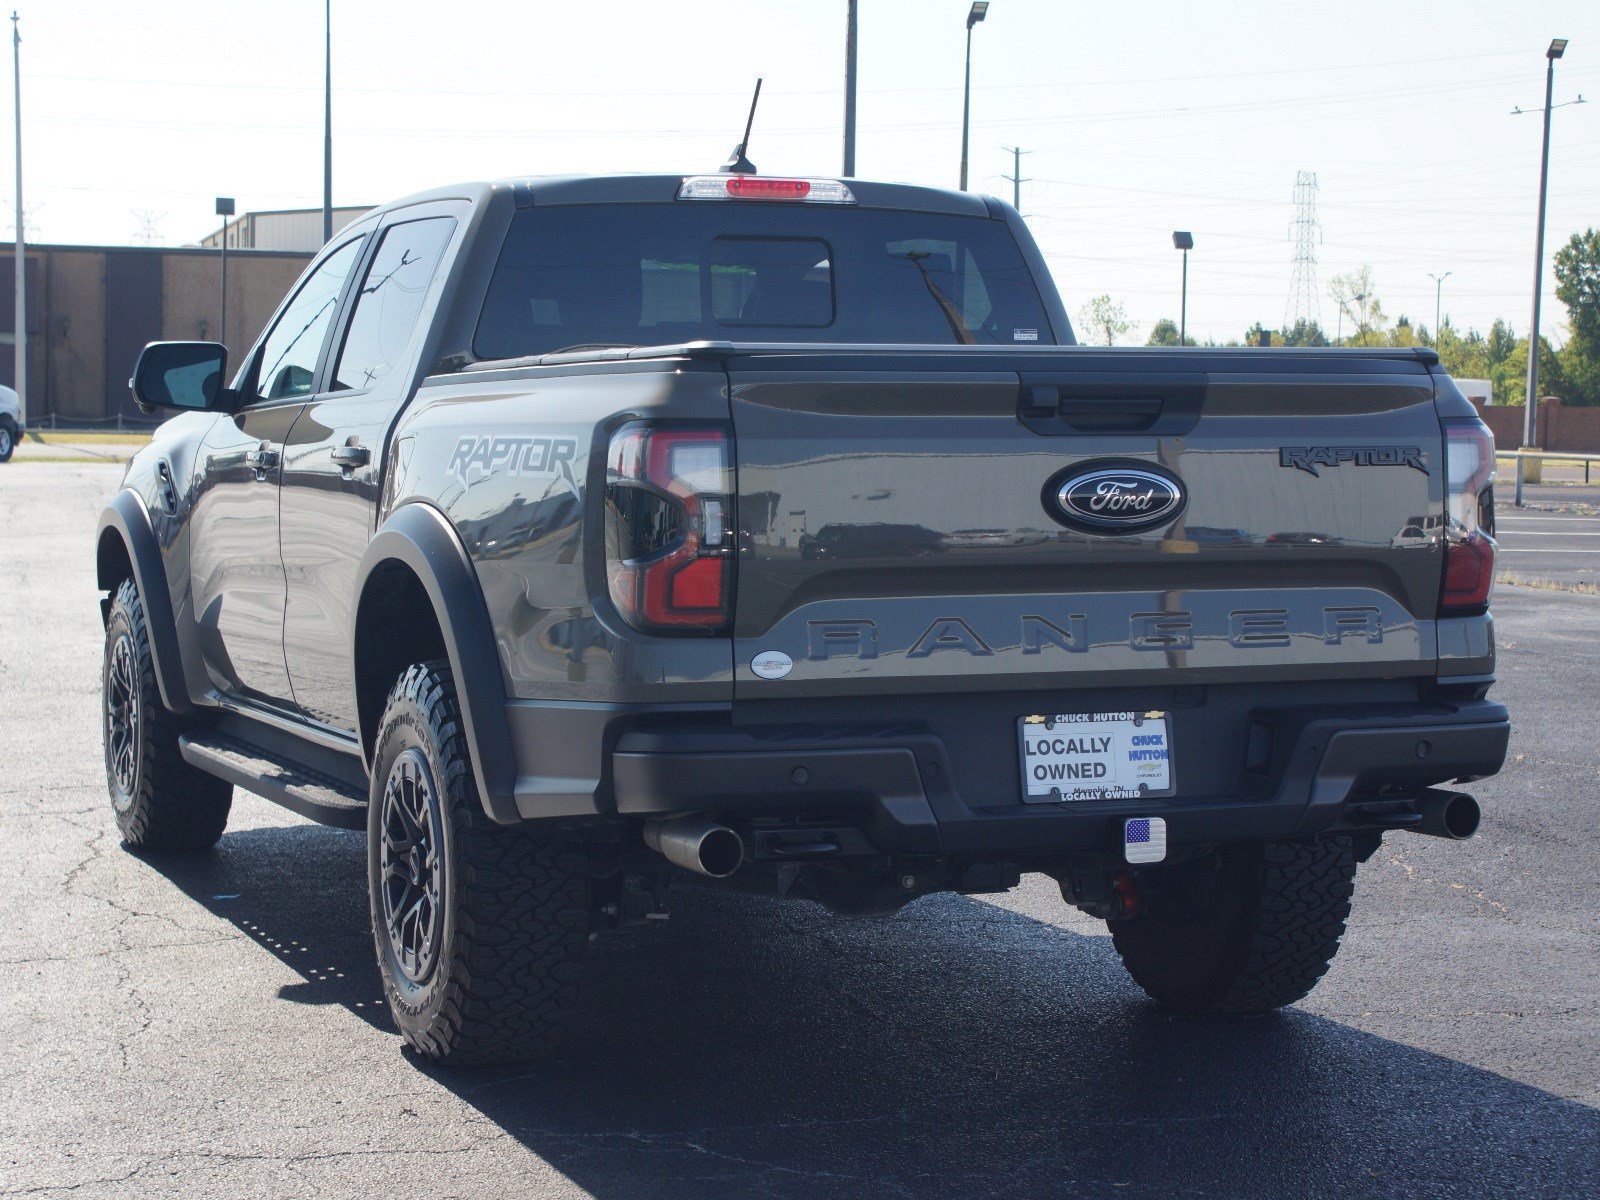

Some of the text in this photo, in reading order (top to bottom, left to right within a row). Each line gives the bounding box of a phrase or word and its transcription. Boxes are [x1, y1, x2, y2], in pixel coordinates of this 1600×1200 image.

[447, 435, 580, 500] RAPTOR
[1279, 446, 1430, 478] RAPTOR
[1089, 481, 1154, 511] Ford
[807, 606, 1384, 661] RANGER
[1055, 711, 1135, 723] CHUCK HUTTON
[1025, 736, 1112, 756] LOCALLY
[1132, 735, 1163, 746] CHUCK
[1129, 749, 1168, 761] HUTTON
[1033, 762, 1107, 781] OWNED
[1061, 789, 1141, 802] LOCALLY OWNED
